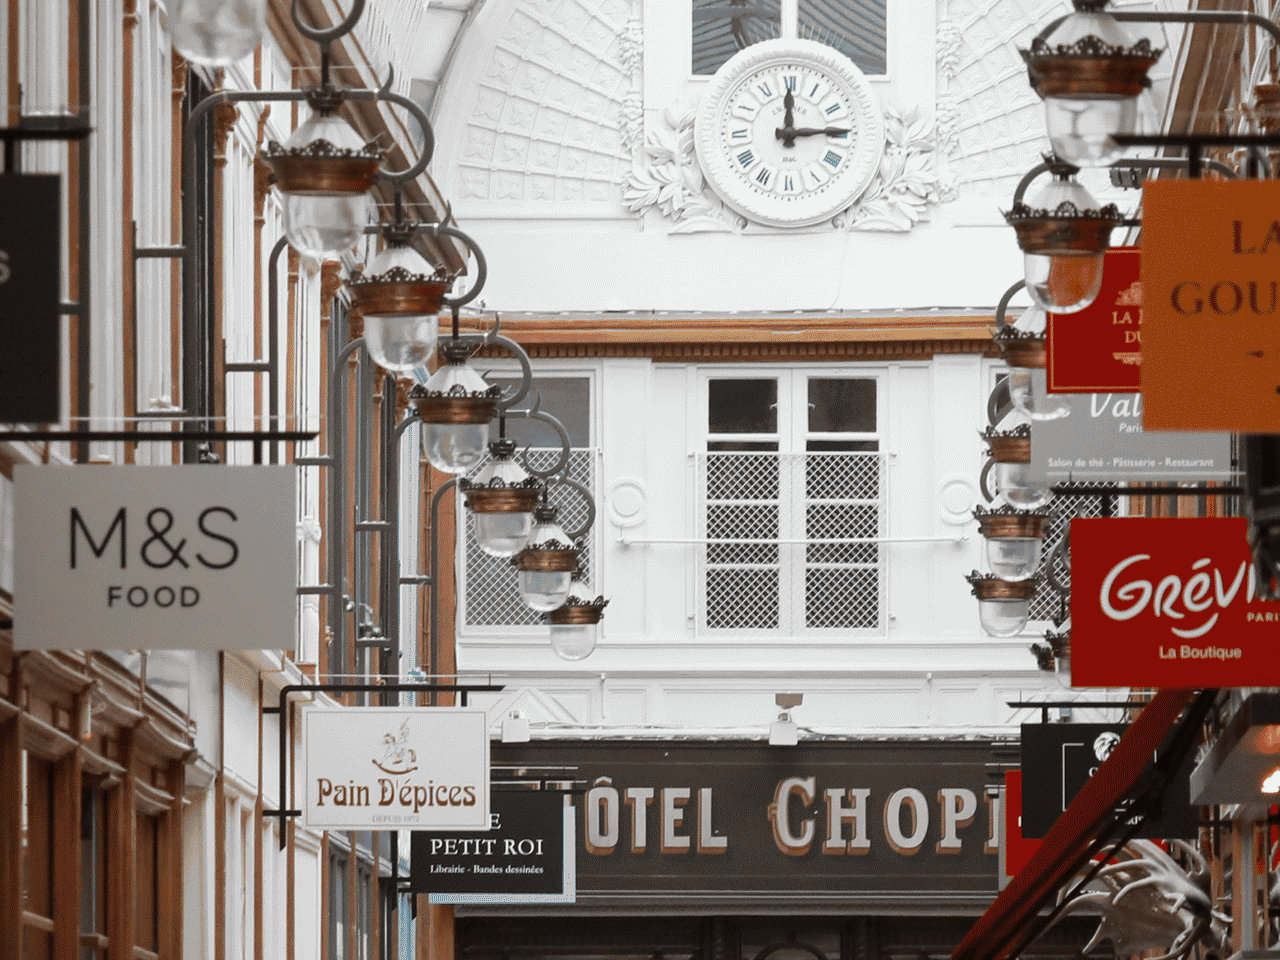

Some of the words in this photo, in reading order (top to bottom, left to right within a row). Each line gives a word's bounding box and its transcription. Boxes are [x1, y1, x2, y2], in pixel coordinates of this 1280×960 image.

[1112, 311, 1133, 325] LA
[1090, 393, 1142, 418] Val
[1048, 457, 1072, 467] Salon
[1075, 457, 1086, 467] de
[1089, 457, 1104, 467] thé
[1165, 457, 1214, 467] Restaurant
[68, 506, 240, 570] M&S
[108, 586, 201, 609] FOOD
[1159, 645, 1177, 659] La
[1180, 645, 1242, 661] Boutique
[316, 778, 371, 807] Pain
[378, 777, 477, 813] D'épices
[491, 813, 502, 829] E
[585, 774, 728, 856] ÔTEL
[768, 775, 1000, 857] CHOPI
[430, 838, 497, 855] PETIT
[503, 838, 544, 855] ROI
[430, 864, 465, 874] Librairie
[473, 864, 503, 874] Bandes
[505, 864, 544, 874] dessinées
